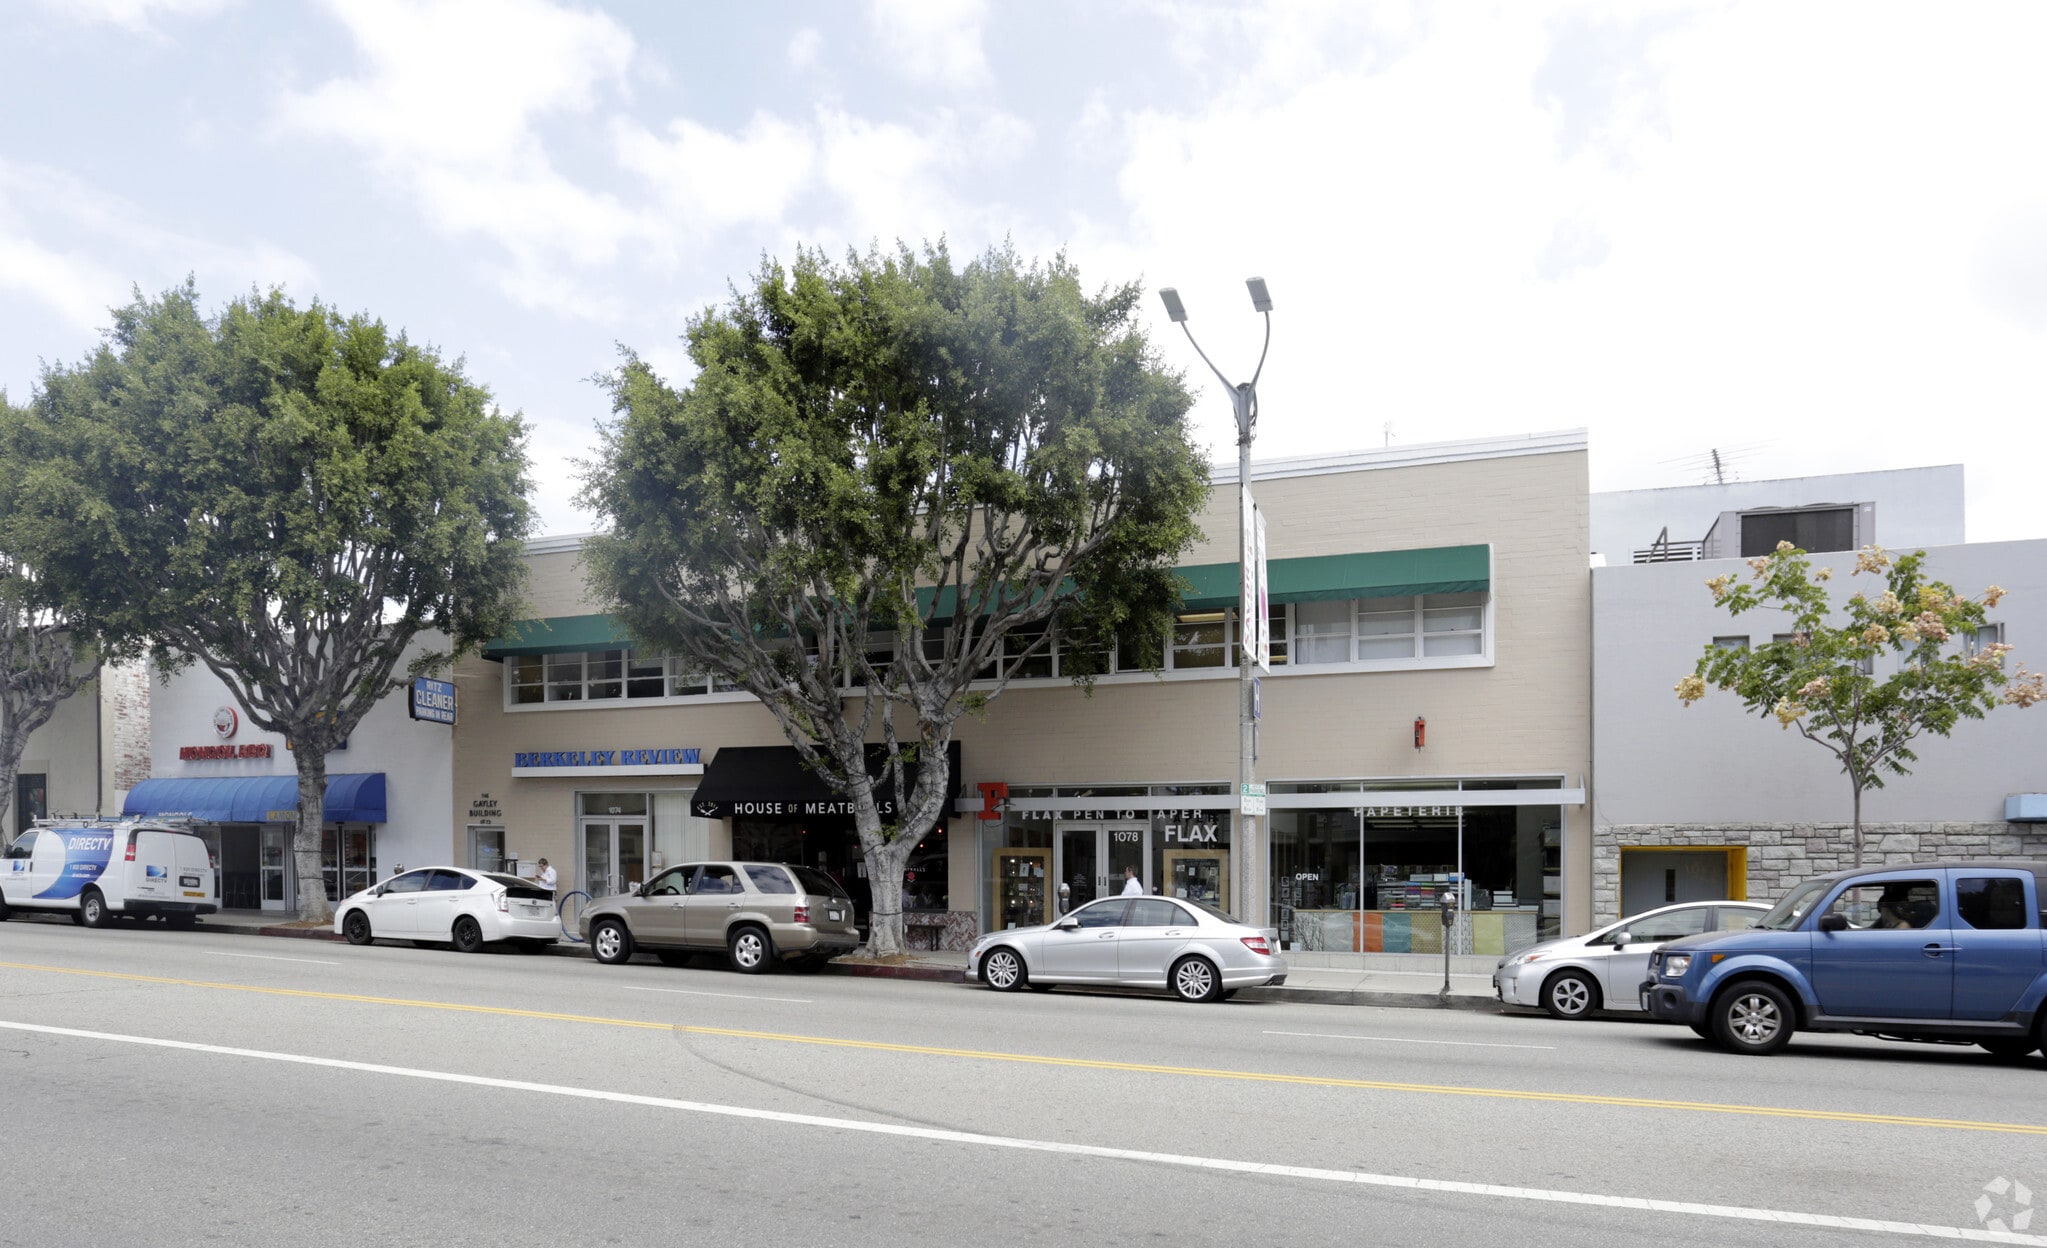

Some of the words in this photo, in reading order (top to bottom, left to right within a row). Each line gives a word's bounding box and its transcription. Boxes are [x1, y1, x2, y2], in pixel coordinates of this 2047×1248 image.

[426, 680, 442, 692] RITZ
[416, 690, 454, 711] CLEANER
[515, 751, 616, 767] BERKELEY
[620, 748, 701, 765] REVIEW
[1242, 784, 1248, 793] 2
[608, 806, 622, 814] 1074
[734, 803, 782, 814] HOUSE
[788, 803, 798, 813] OF
[805, 802, 892, 814] MEATBLS
[1022, 810, 1063, 820] FLAX
[1073, 810, 1104, 820] PEN
[1116, 809, 1135, 819] TO
[1114, 832, 1139, 842] 1078
[1165, 825, 1218, 842] FLAX
[69, 837, 112, 851] DIRECTV
[1295, 873, 1319, 881] OPEN
